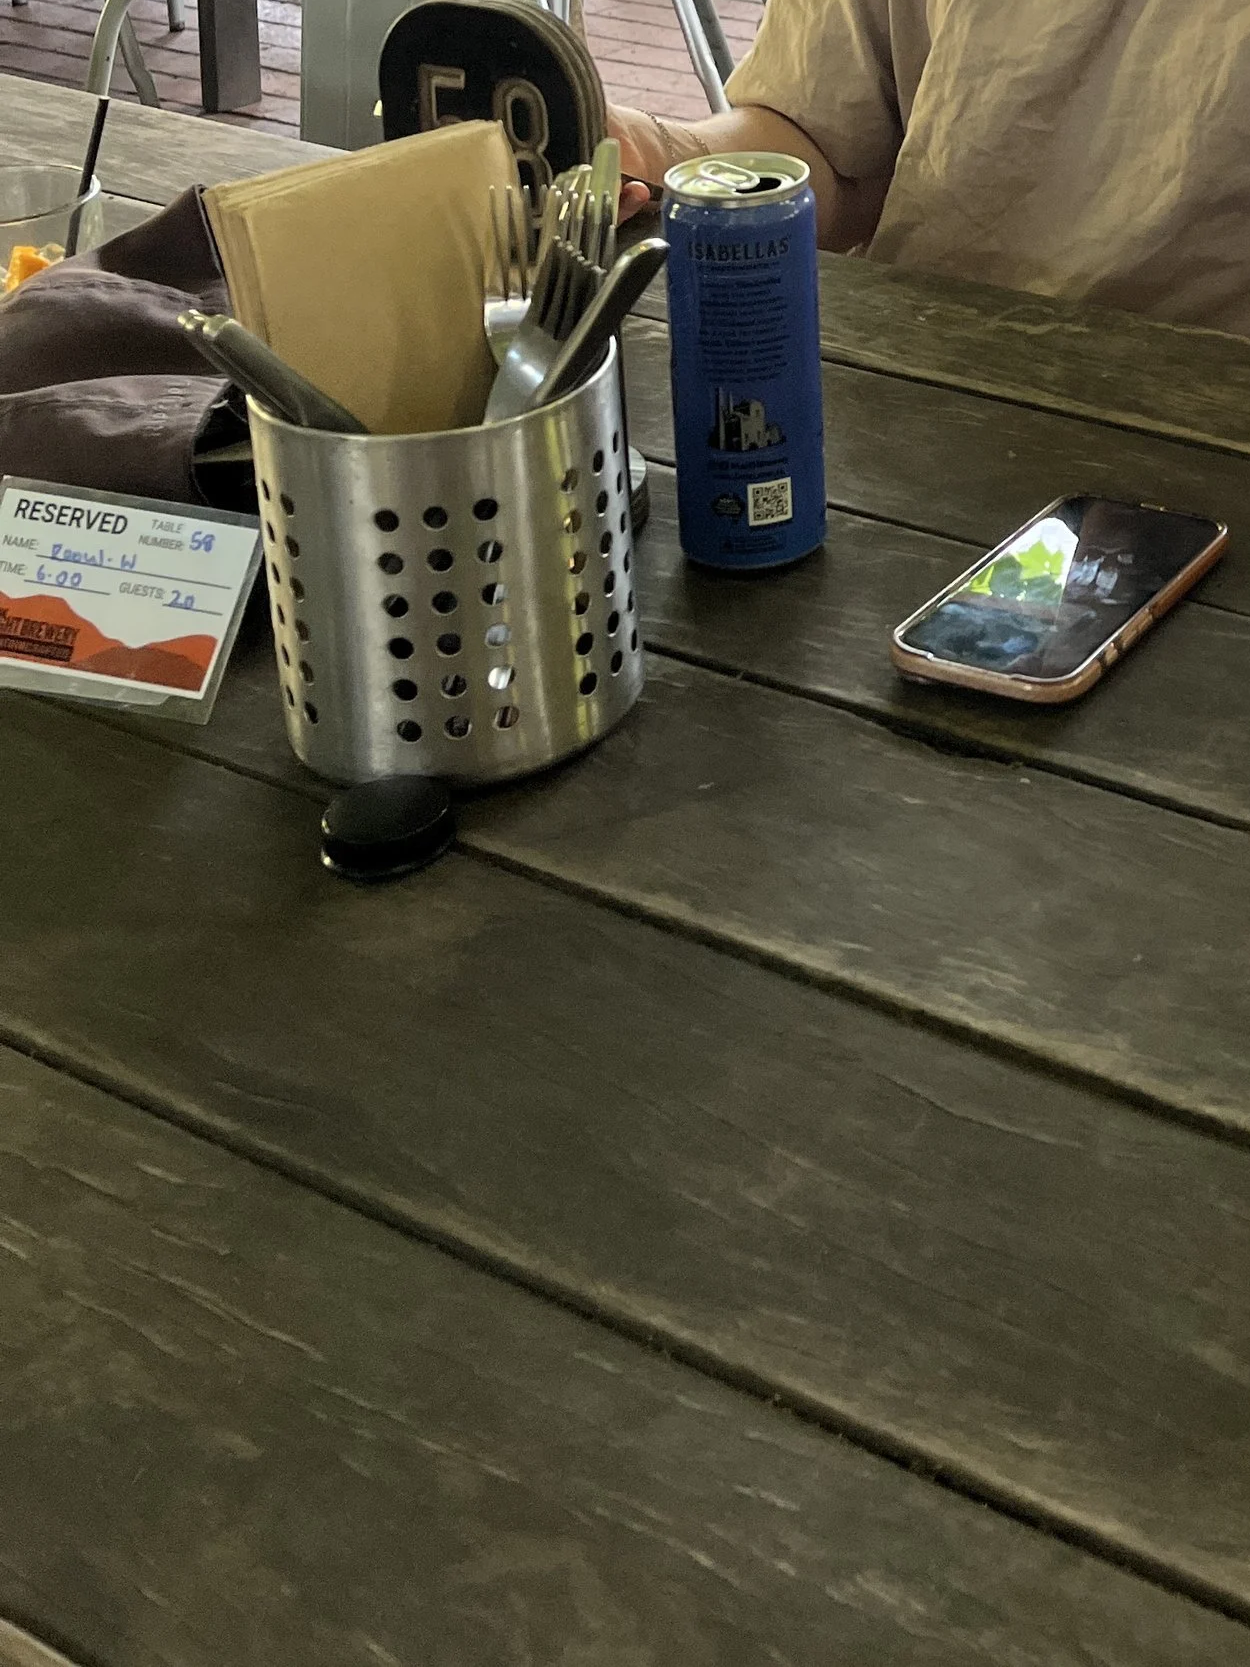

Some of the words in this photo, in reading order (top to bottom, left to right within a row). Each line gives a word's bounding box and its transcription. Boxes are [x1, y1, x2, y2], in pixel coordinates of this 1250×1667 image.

[14, 498, 128, 535] RESERVED
[151, 518, 185, 534] TABLE
[168, 589, 195, 610] 20
